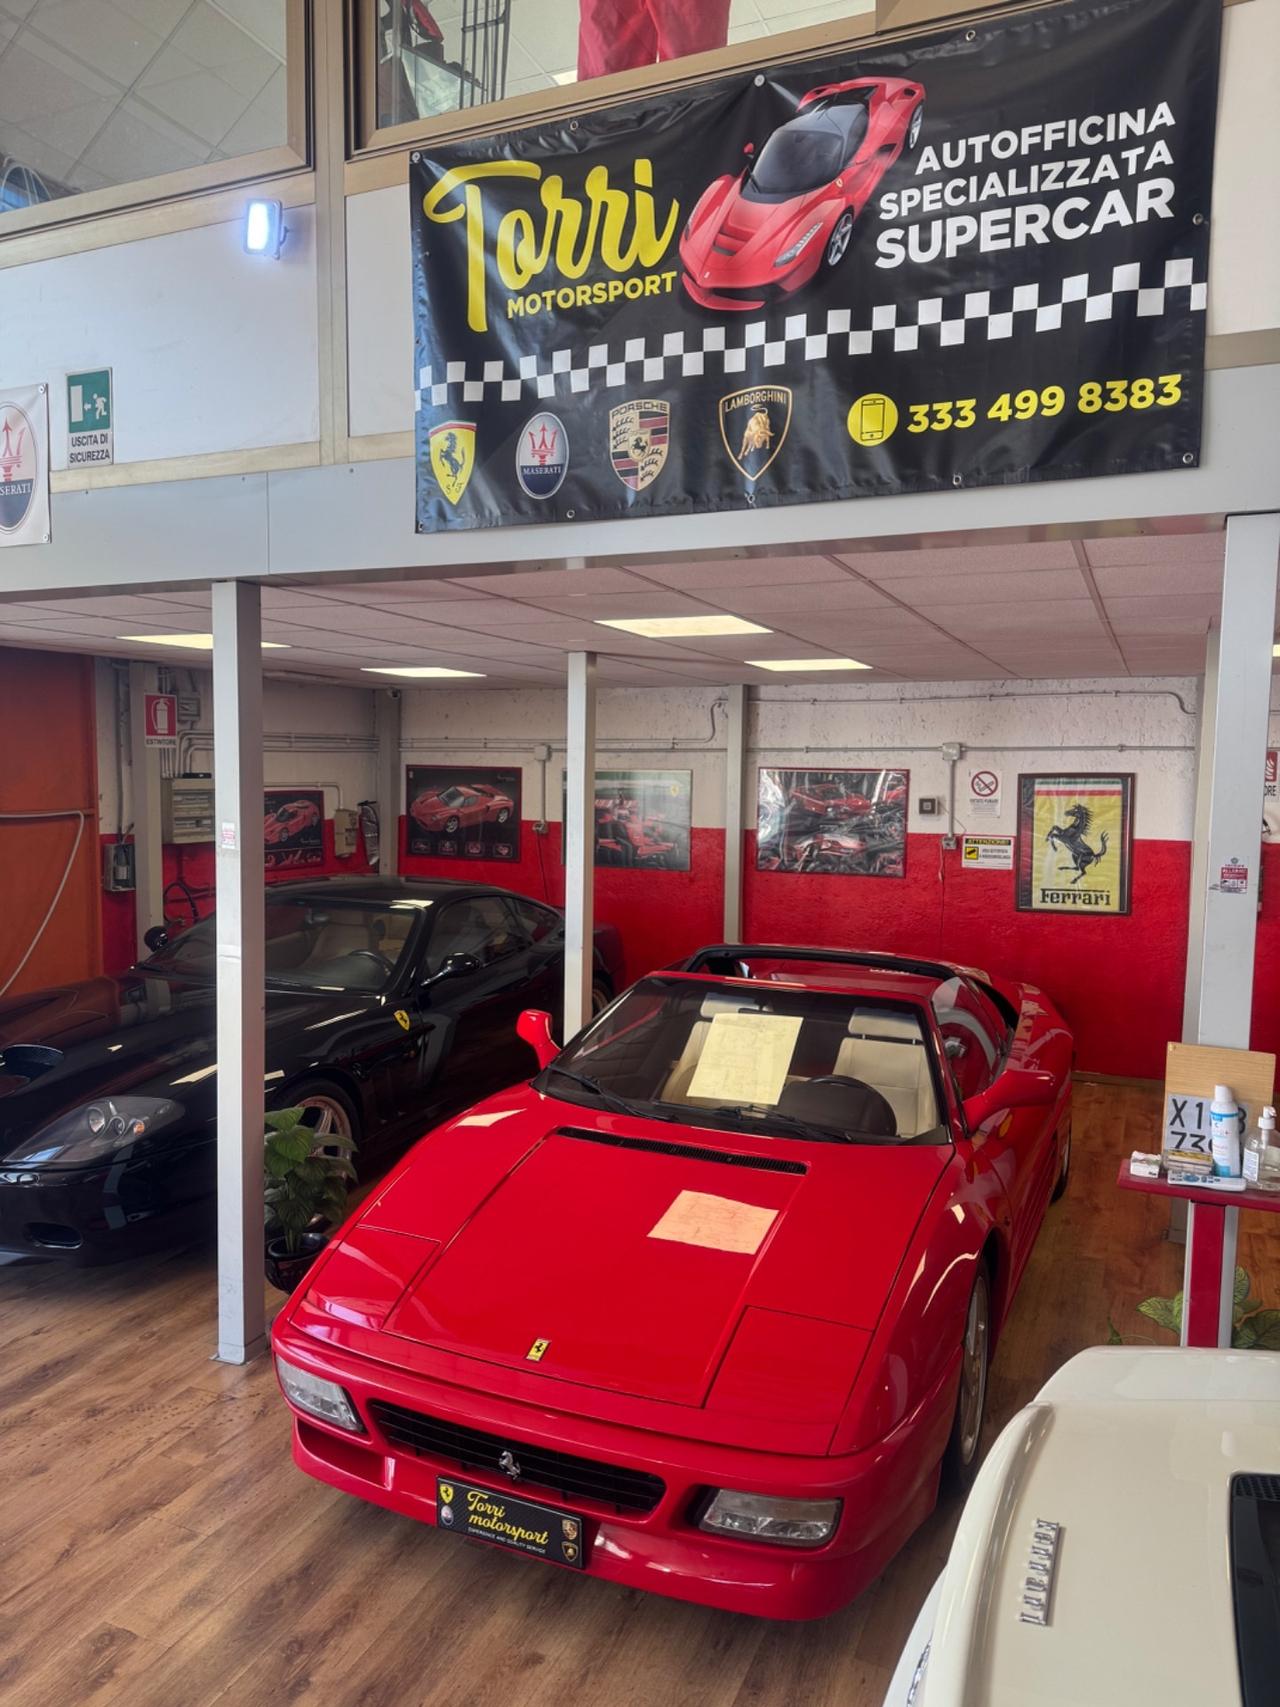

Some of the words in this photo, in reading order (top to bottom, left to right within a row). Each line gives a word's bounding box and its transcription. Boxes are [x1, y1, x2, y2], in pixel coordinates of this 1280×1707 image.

[915, 101, 1176, 175] AUTOFFICINA
[879, 139, 1174, 220] SPECIALIZZATA
[874, 177, 1176, 269] SUPERCAR
[423, 158, 680, 332] Torri
[507, 271, 678, 319] MOTORSPORT
[611, 401, 669, 418] PORSCHE
[724, 390, 788, 412] LAMBORGHINI
[907, 398, 977, 434] 333
[987, 385, 1066, 422] 499
[1077, 373, 1182, 413] 8383
[71, 434, 98, 447] USCITA
[100, 433, 109, 445] DI
[70, 449, 110, 463] SICUREZZA
[523, 466, 561, 475] MASERATI
[1040, 888, 1111, 906] Ferrari
[467, 1491, 506, 1518] Torri
[468, 1515, 549, 1545] motorsport
